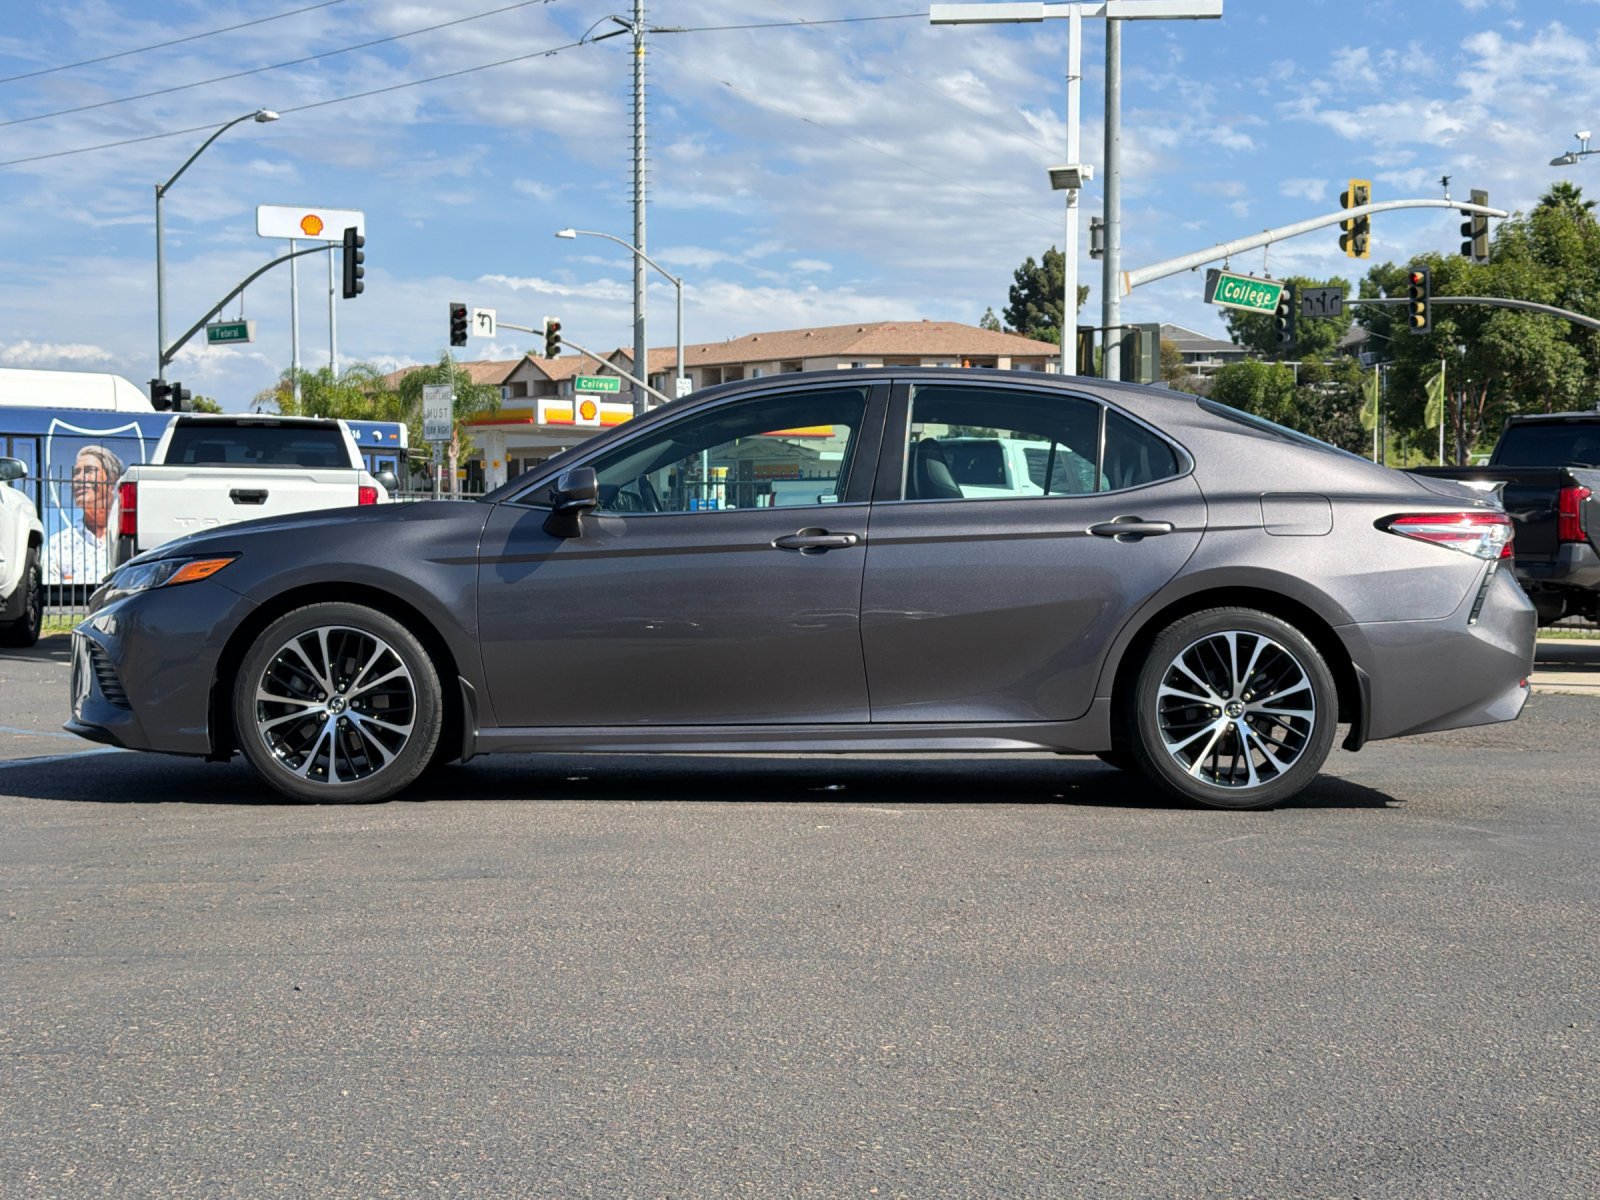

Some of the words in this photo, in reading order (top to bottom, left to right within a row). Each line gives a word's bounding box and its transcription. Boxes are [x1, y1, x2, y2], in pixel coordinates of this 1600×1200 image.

[1225, 282, 1271, 307] College
[216, 328, 239, 338] Federal
[581, 380, 614, 390] College
[427, 408, 448, 418] MUST
